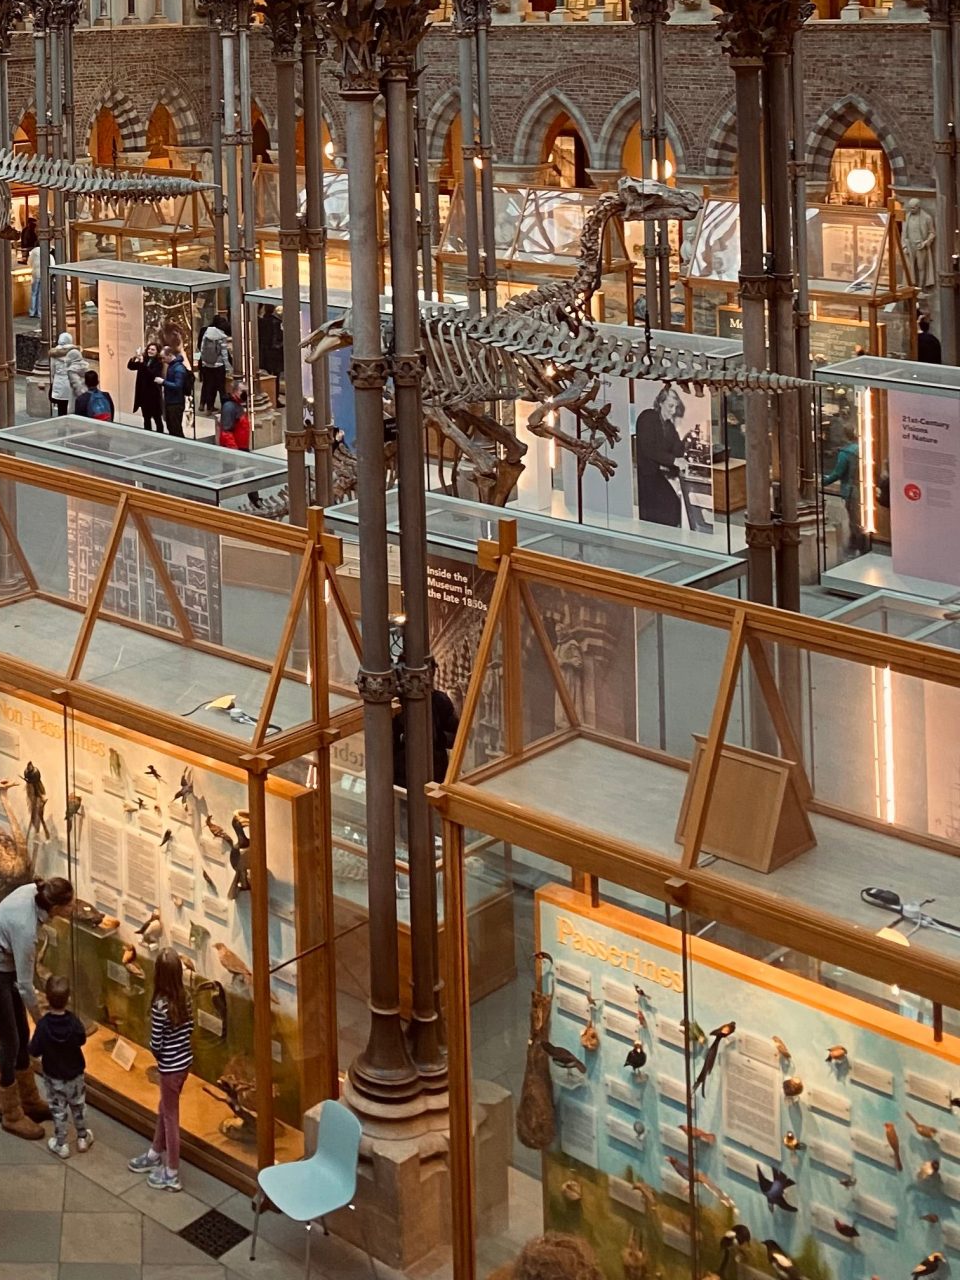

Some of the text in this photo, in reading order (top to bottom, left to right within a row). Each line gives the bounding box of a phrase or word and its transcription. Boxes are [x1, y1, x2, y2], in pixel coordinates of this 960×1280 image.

[902, 432, 938, 444] of Nature
[426, 565, 468, 584] Inside the
[427, 577, 473, 596] Museum in
[427, 588, 488, 612] the late 1850s
[556, 915, 684, 994] Passerines
